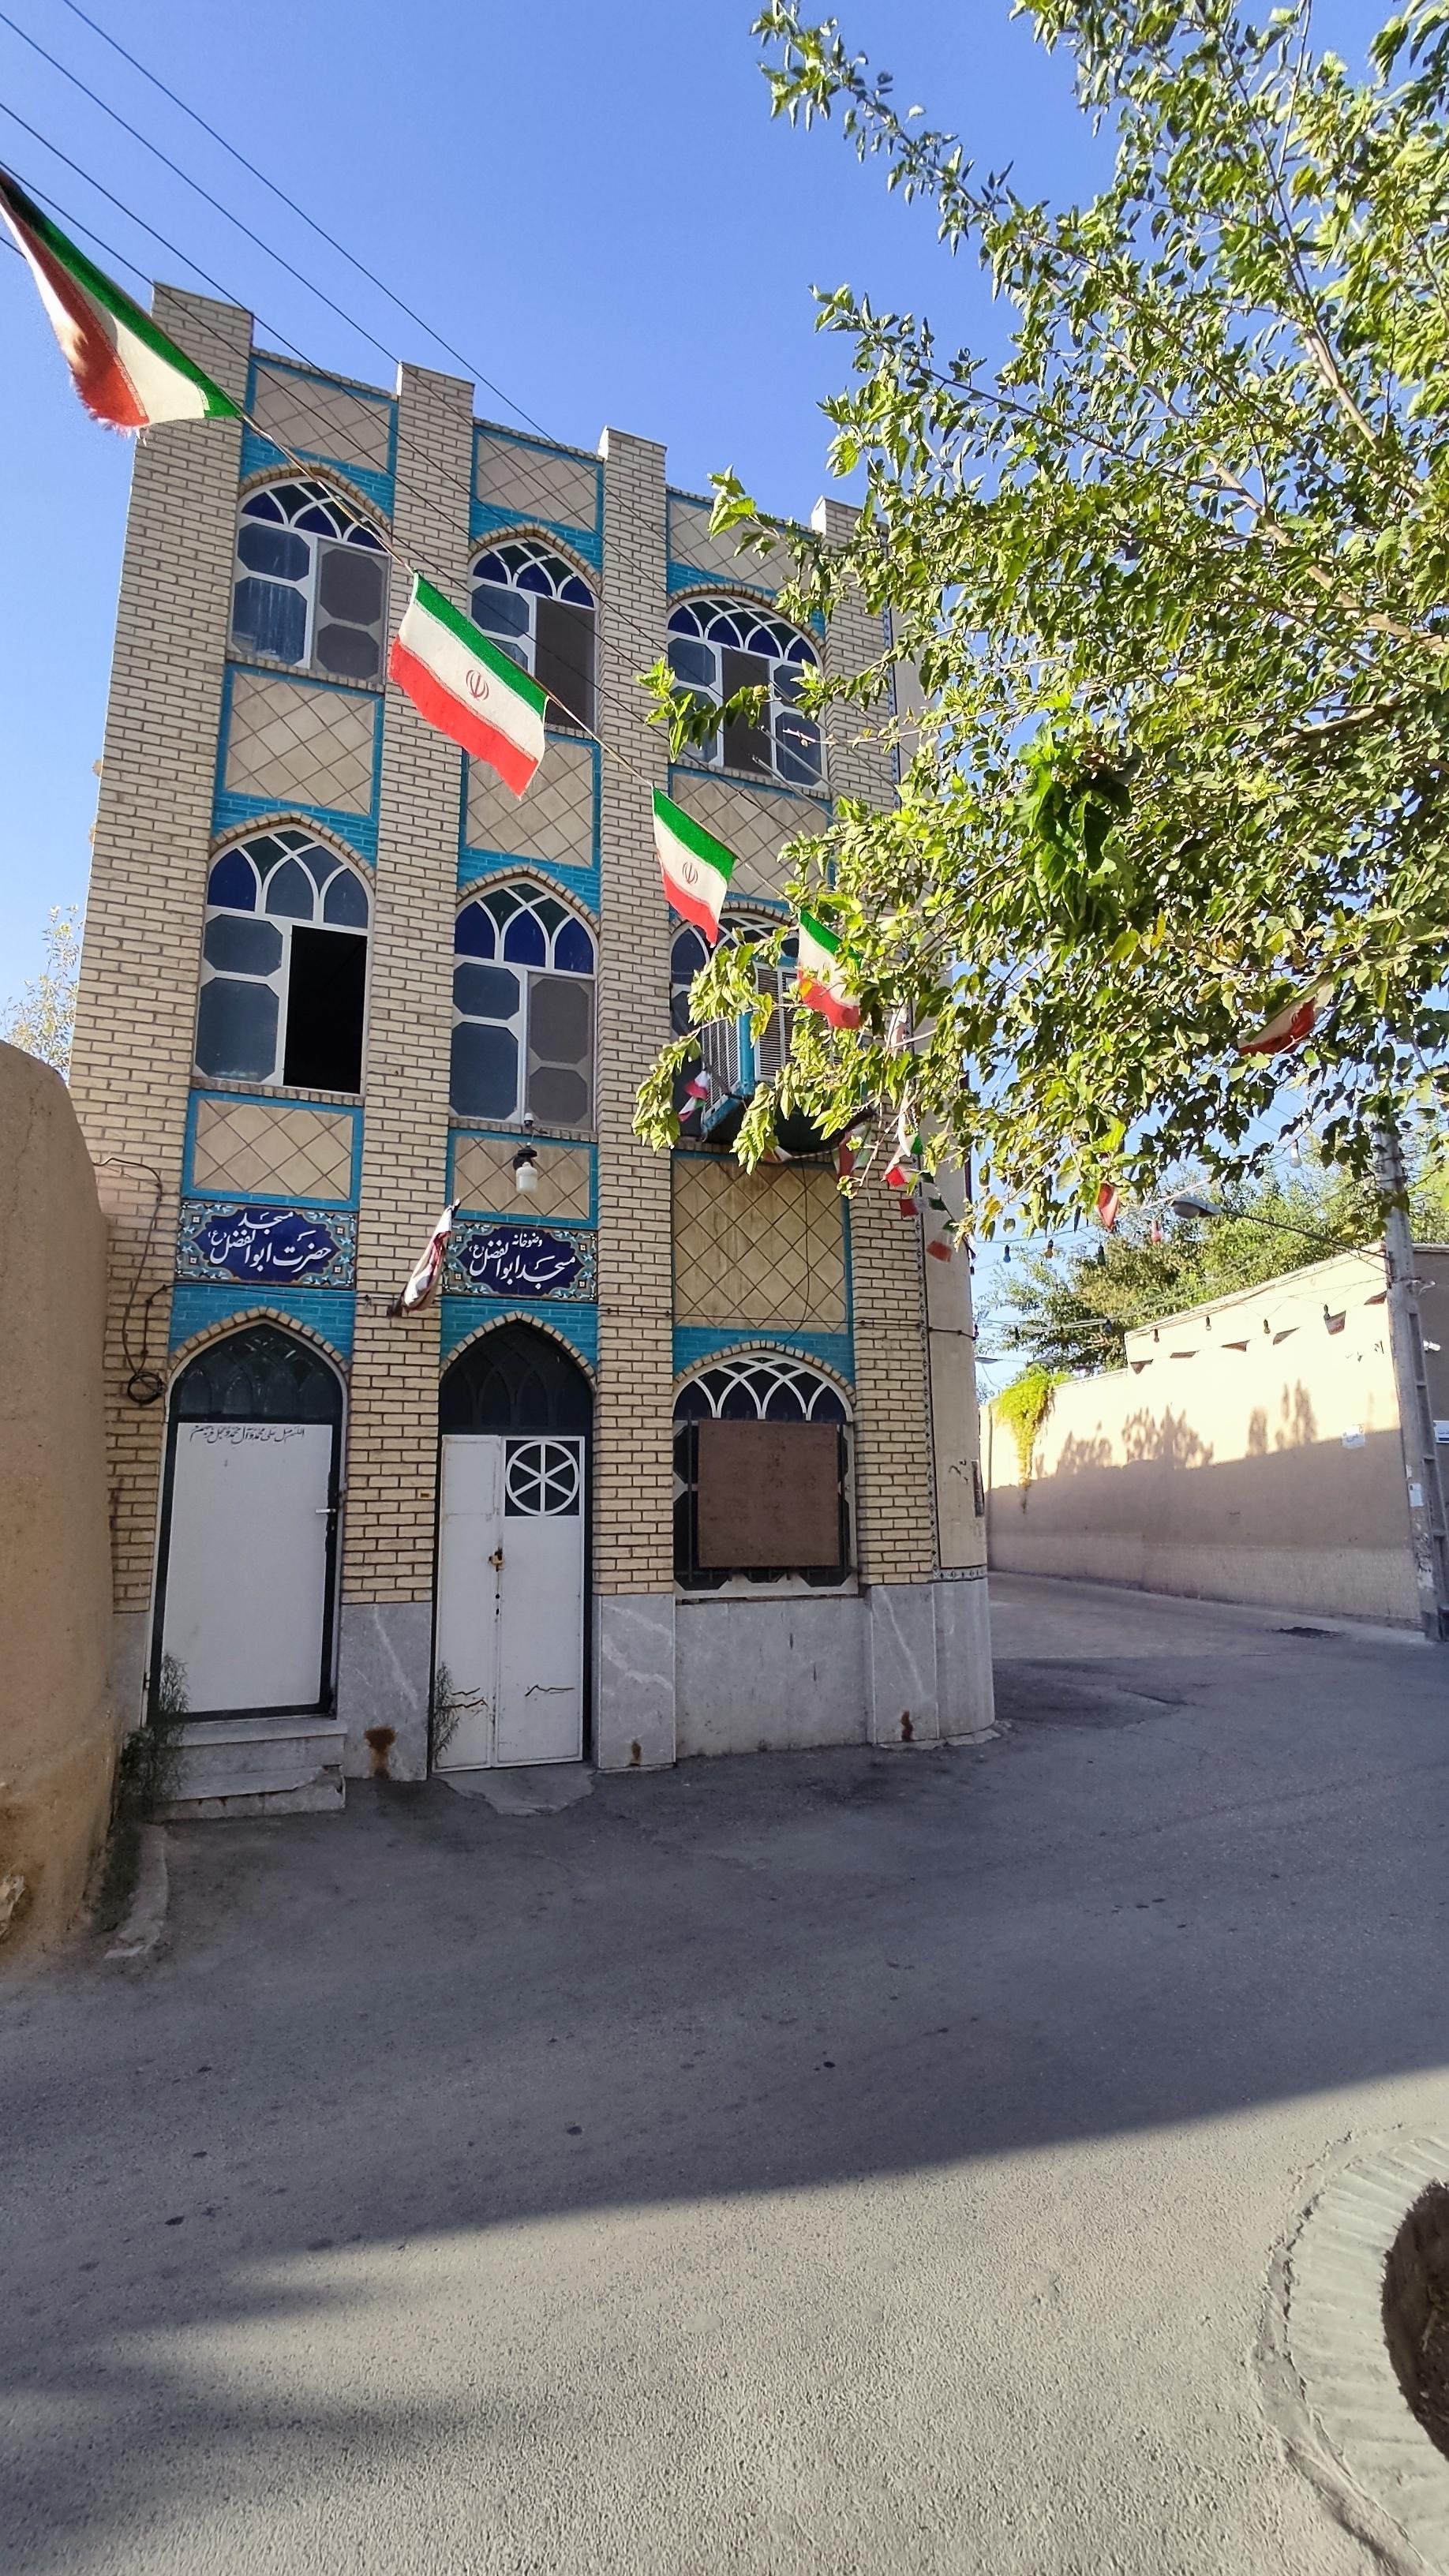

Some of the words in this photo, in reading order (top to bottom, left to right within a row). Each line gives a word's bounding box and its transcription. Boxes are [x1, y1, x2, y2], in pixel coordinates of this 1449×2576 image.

[238, 1211, 294, 1234] مسجد
[209, 1230, 272, 1272] ابوالفضل
[272, 1230, 331, 1273] حضرت
[469, 1240, 521, 1286] ابوالفضل
[516, 1255, 576, 1290] مسجد
